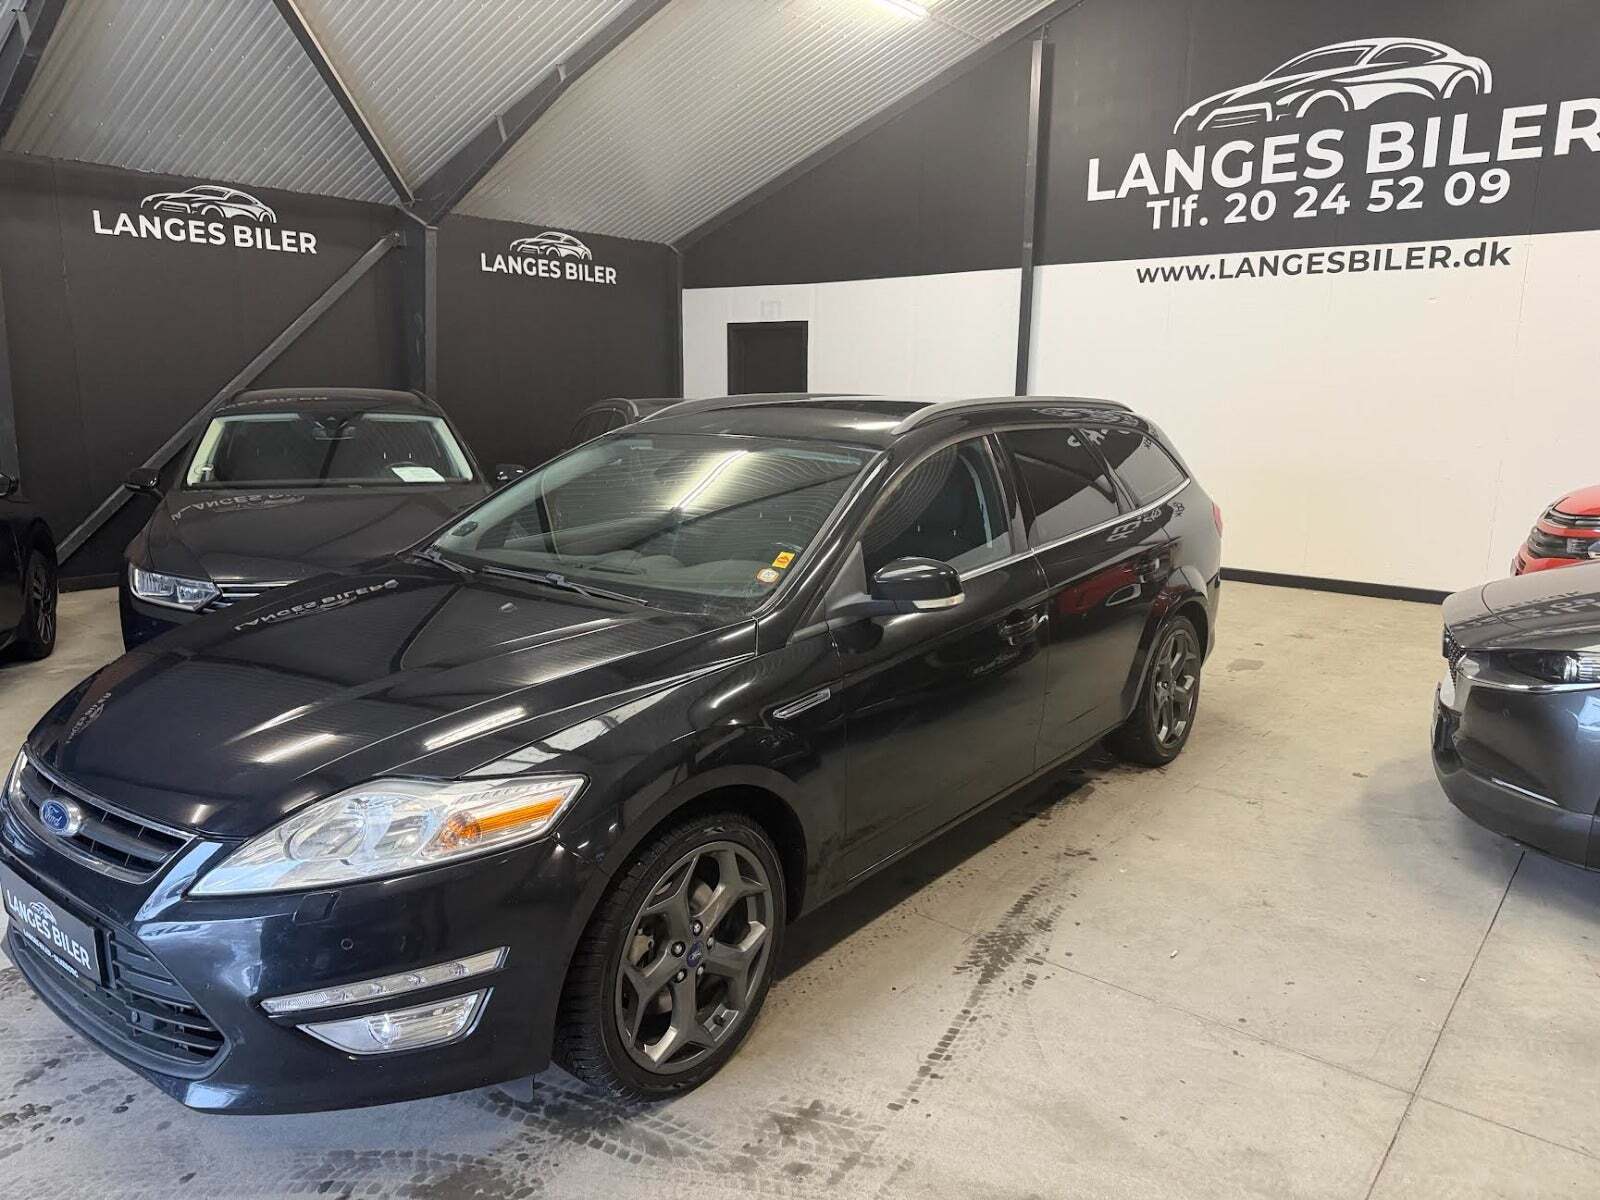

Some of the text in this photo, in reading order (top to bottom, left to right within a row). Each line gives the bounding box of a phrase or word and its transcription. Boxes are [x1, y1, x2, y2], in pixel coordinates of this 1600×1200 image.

[1087, 97, 1600, 202] LANGES BILER
[1147, 167, 1511, 230] Tlf. 20 24 52 09
[92, 209, 318, 255] LANGES BILER
[480, 252, 617, 285] LANGES BILER
[1136, 241, 1512, 284] www.LANGESBILER.dk
[44, 804, 63, 827] Ford
[6, 888, 52, 940] LANGES
[51, 925, 92, 970] BILER
